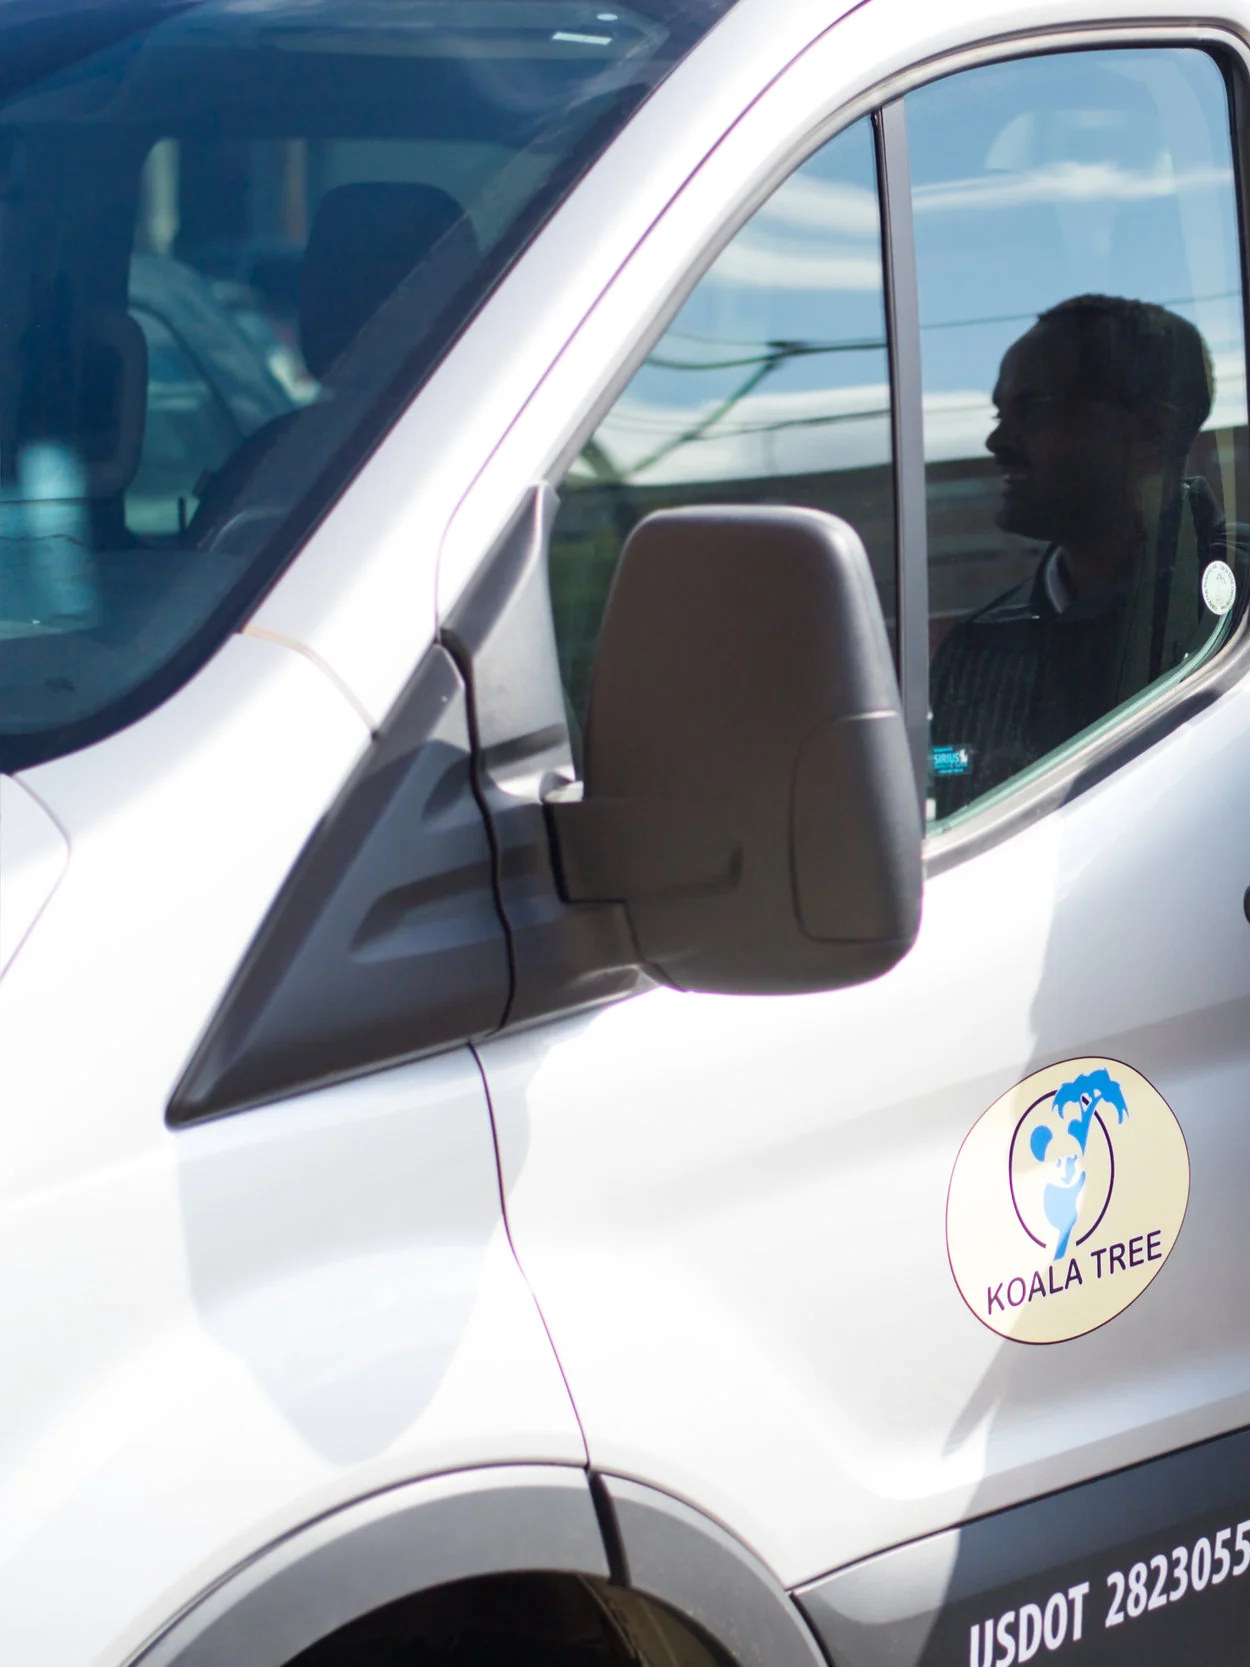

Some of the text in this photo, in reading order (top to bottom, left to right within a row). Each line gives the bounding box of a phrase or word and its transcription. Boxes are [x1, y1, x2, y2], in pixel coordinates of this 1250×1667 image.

[987, 1230, 1162, 1315] KOALA TREE
[970, 1582, 1090, 1667] USDOT
